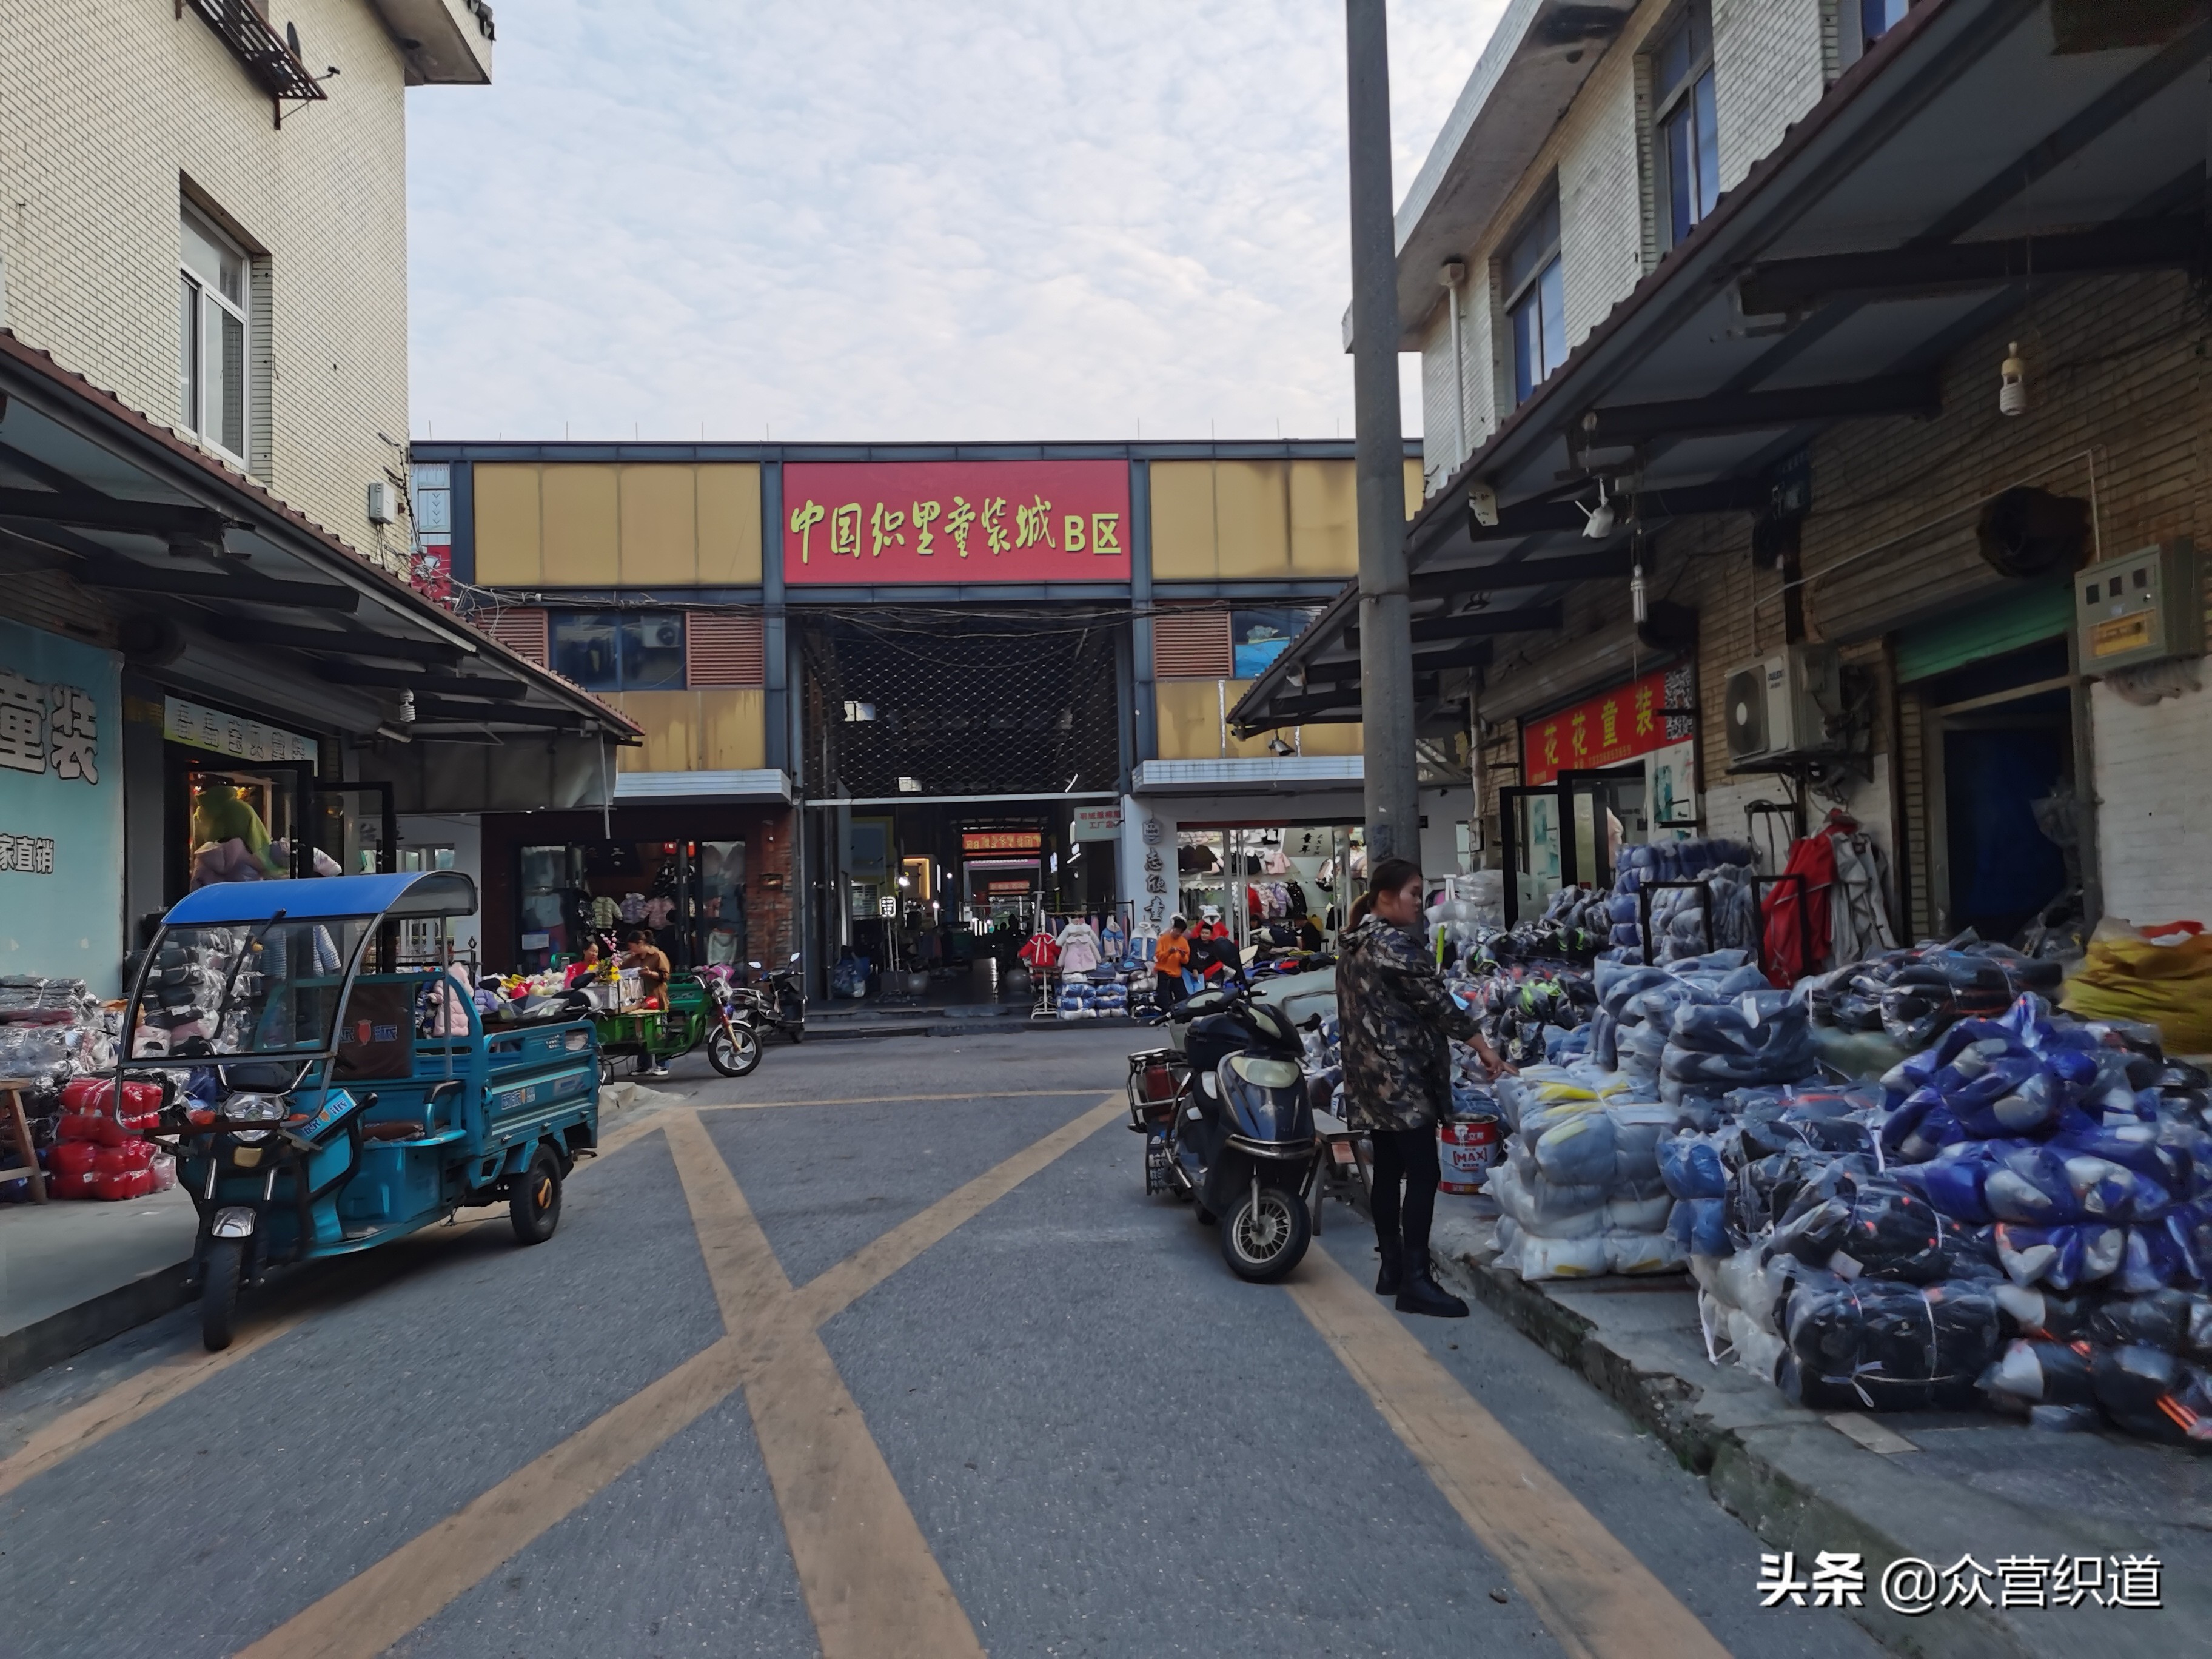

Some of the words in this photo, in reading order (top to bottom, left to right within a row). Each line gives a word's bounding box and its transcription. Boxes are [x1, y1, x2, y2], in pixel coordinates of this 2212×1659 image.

[791, 494, 1121, 564] 中国织里童装城B区
[0, 669, 99, 785] 童装
[1543, 685, 1654, 766] 花花童装
[0, 833, 54, 874] 家直销
